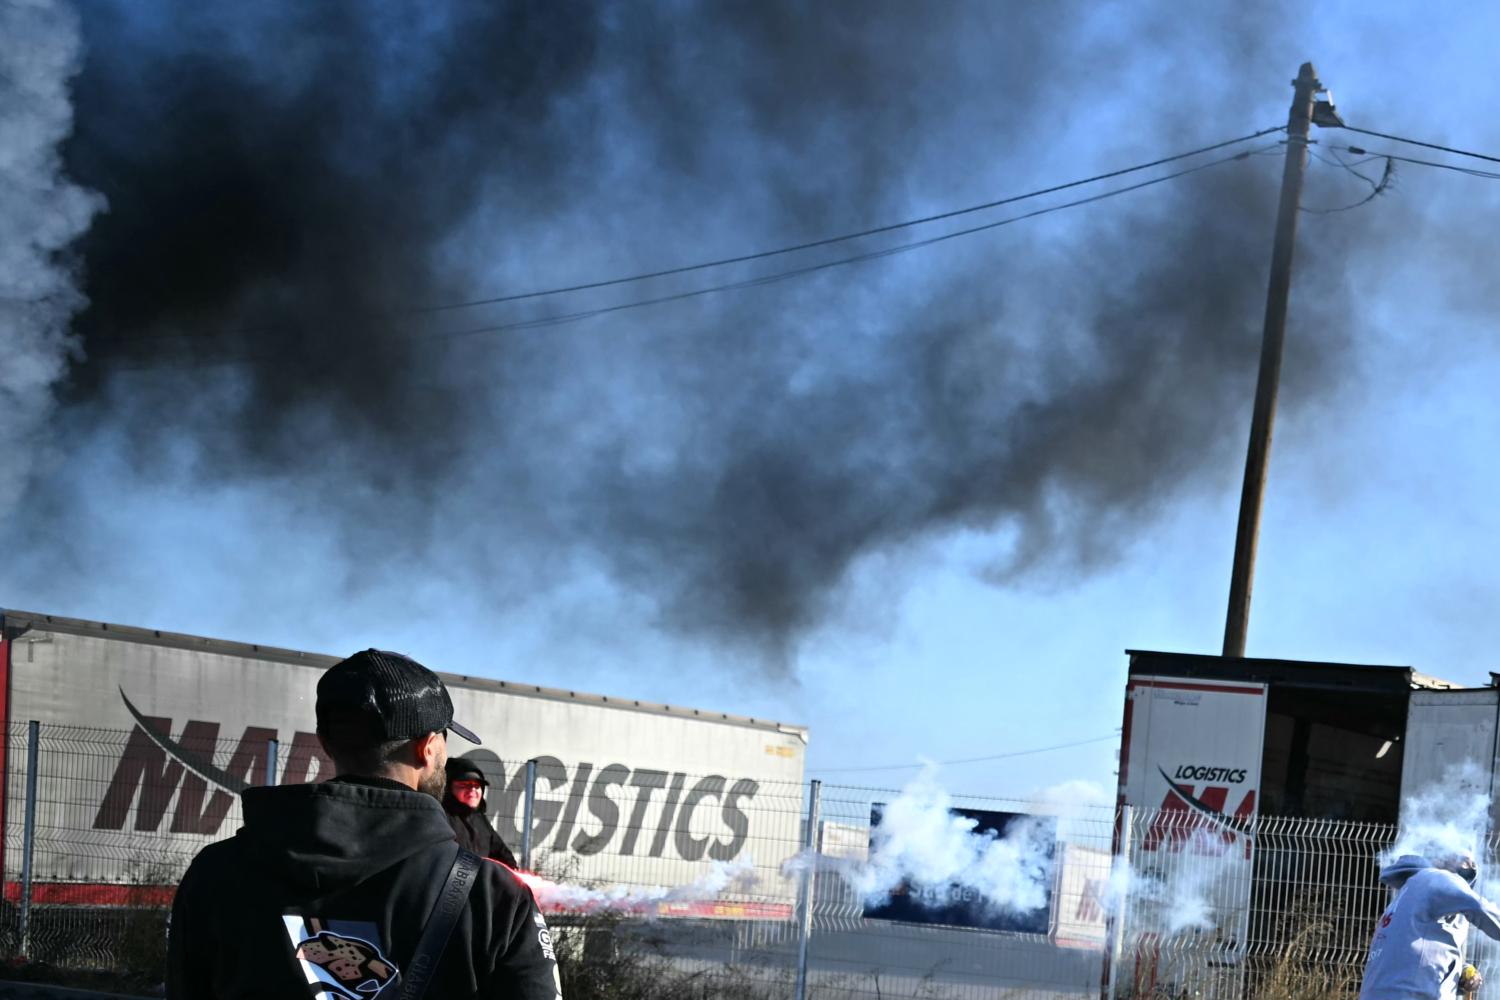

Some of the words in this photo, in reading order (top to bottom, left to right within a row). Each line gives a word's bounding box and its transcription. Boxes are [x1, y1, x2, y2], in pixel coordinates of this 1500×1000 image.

[92, 715, 337, 835] MAR
[457, 748, 760, 862] OGISTICS
[1174, 765, 1248, 783] LOGISTICS
